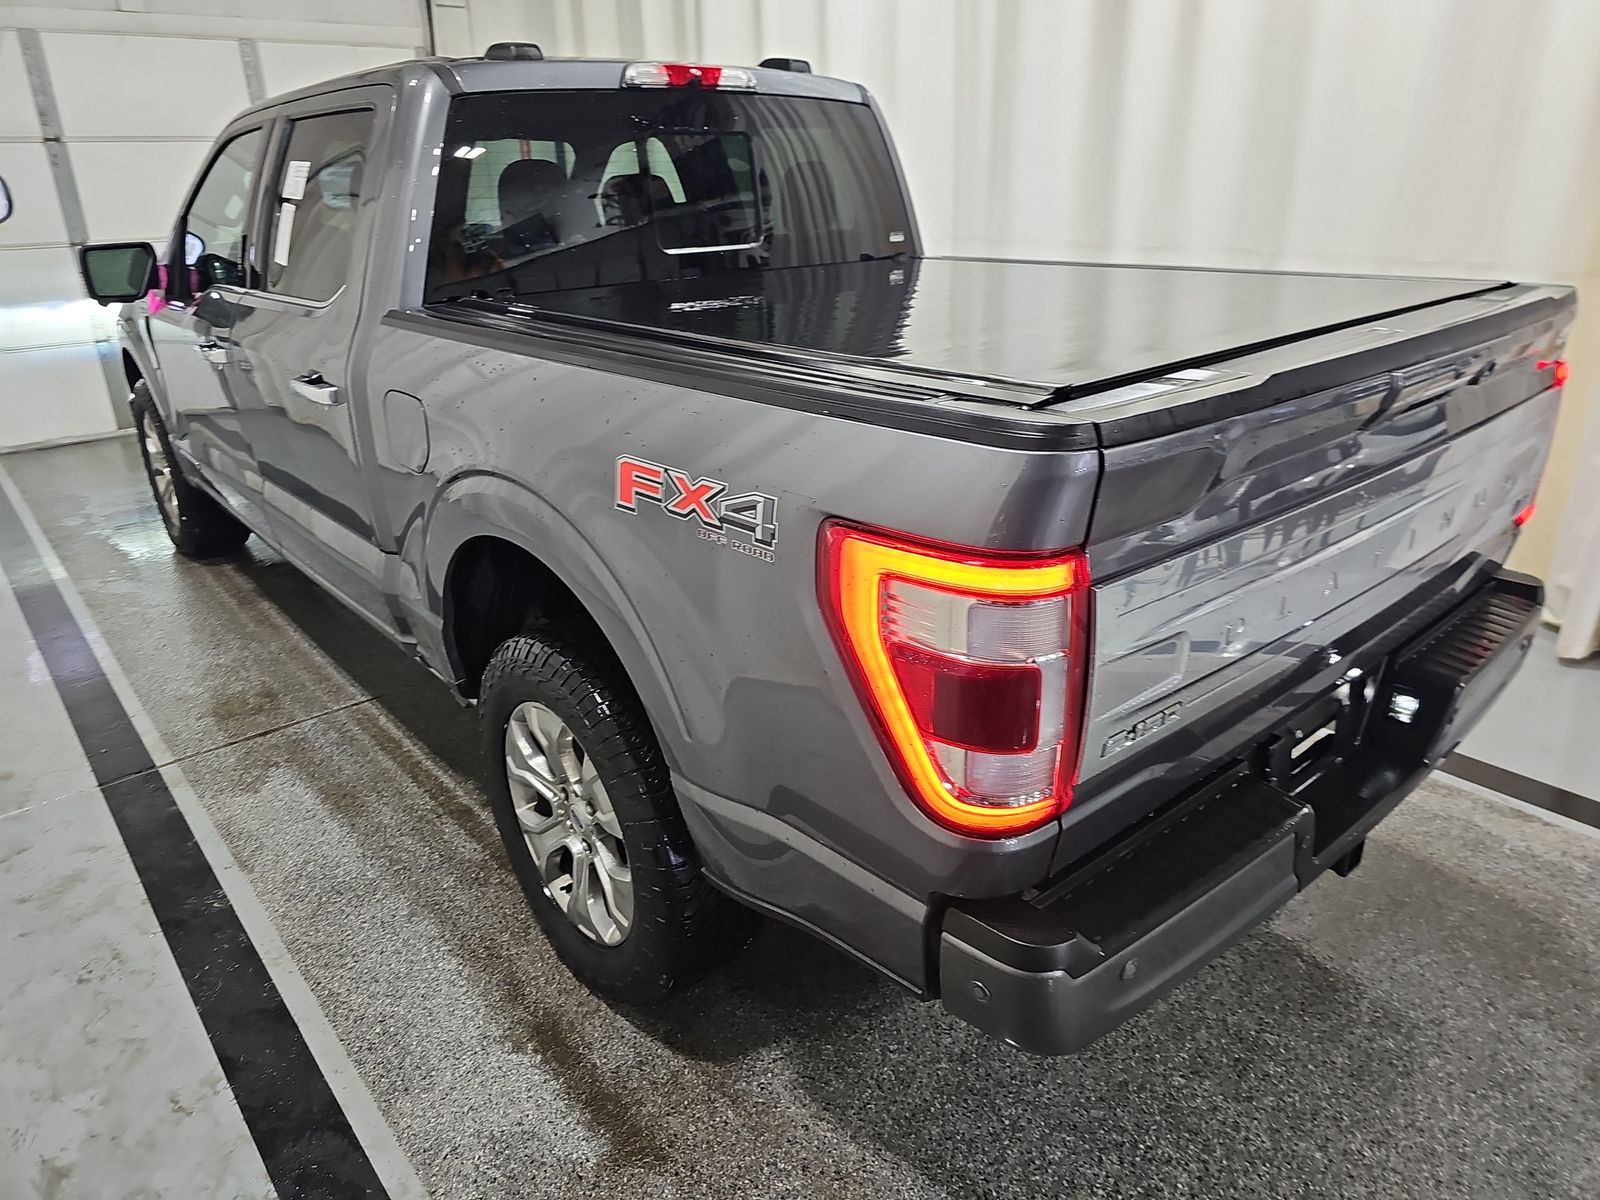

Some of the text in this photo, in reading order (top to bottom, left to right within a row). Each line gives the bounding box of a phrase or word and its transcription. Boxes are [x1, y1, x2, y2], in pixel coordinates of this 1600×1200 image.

[614, 454, 778, 550] FX4
[697, 528, 775, 562] OFF ROAD
